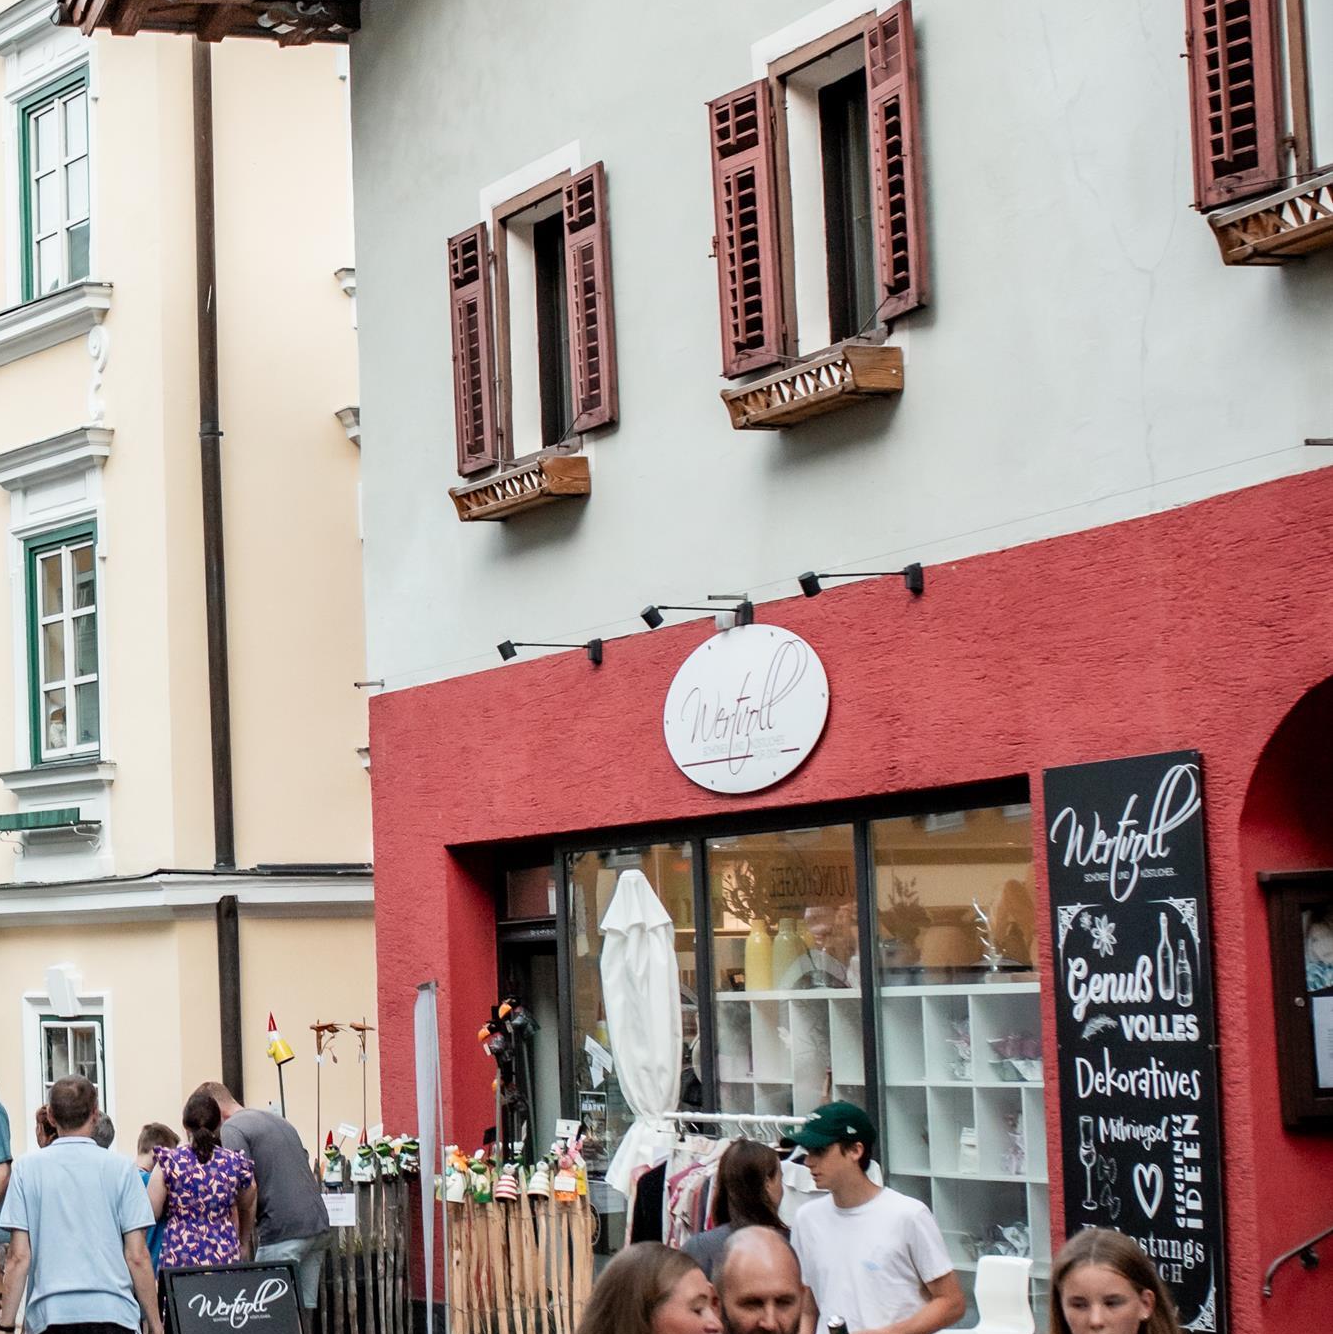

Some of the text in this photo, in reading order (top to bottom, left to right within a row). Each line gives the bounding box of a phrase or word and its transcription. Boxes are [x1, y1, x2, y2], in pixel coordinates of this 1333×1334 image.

[1050, 763, 1201, 903] Wertvoll
[1067, 954, 1154, 1023] Genuß
[1120, 1013, 1201, 1043] VOLLES
[1074, 1046, 1202, 1102] Dekoratives
[1098, 1115, 1169, 1152] Mitbringsel
[1182, 1114, 1204, 1230] IDEEN
[188, 1278, 289, 1329] Wertvoll
